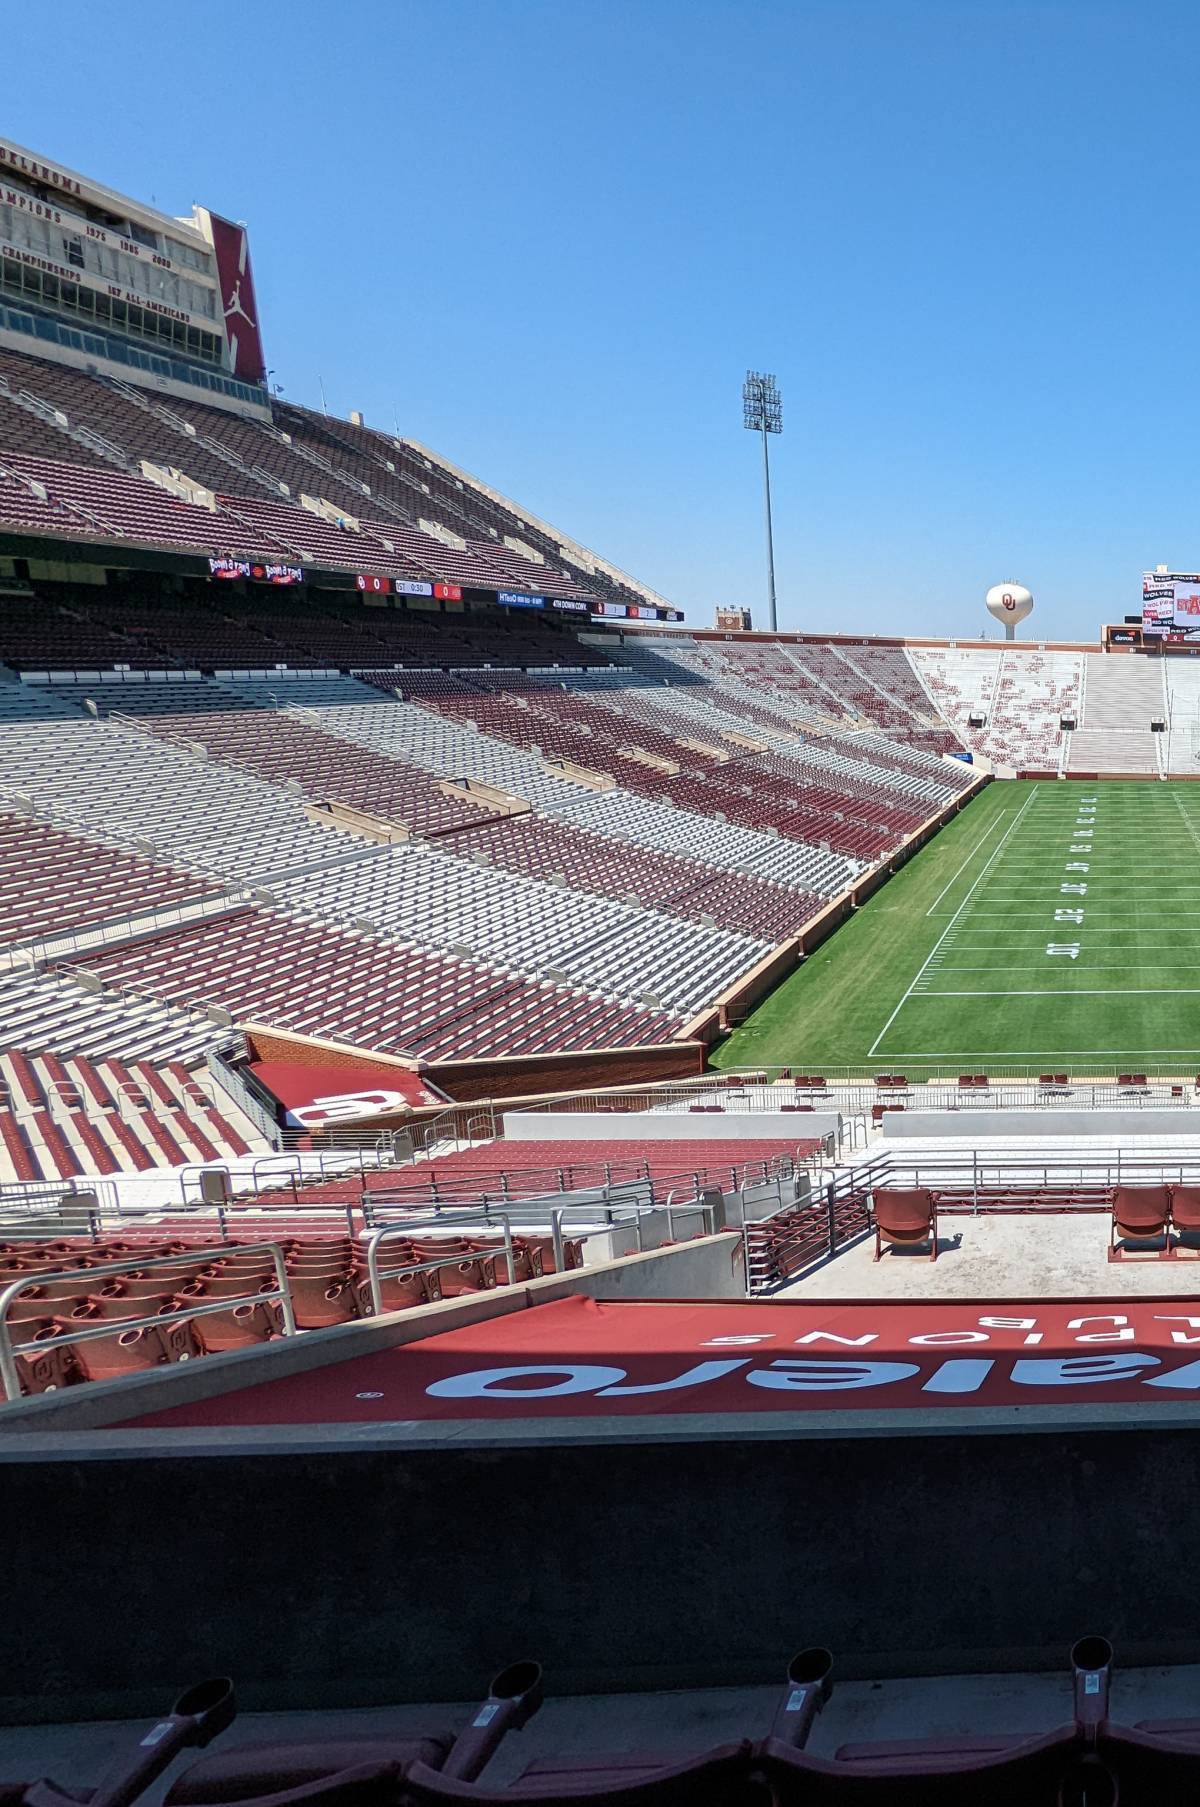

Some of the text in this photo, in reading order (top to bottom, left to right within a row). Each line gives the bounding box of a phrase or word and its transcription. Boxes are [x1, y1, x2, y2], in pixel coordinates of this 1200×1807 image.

[86, 225, 106, 241] 1975
[2, 245, 81, 282] CHAMPIONSHIPS
[126, 292, 190, 323] ALL-AMERICANS
[1002, 593, 1016, 611] OU
[1115, 634, 1134, 642] devon
[1069, 844, 1092, 852] 50
[1054, 908, 1084, 921] 20
[1046, 942, 1081, 956] 10
